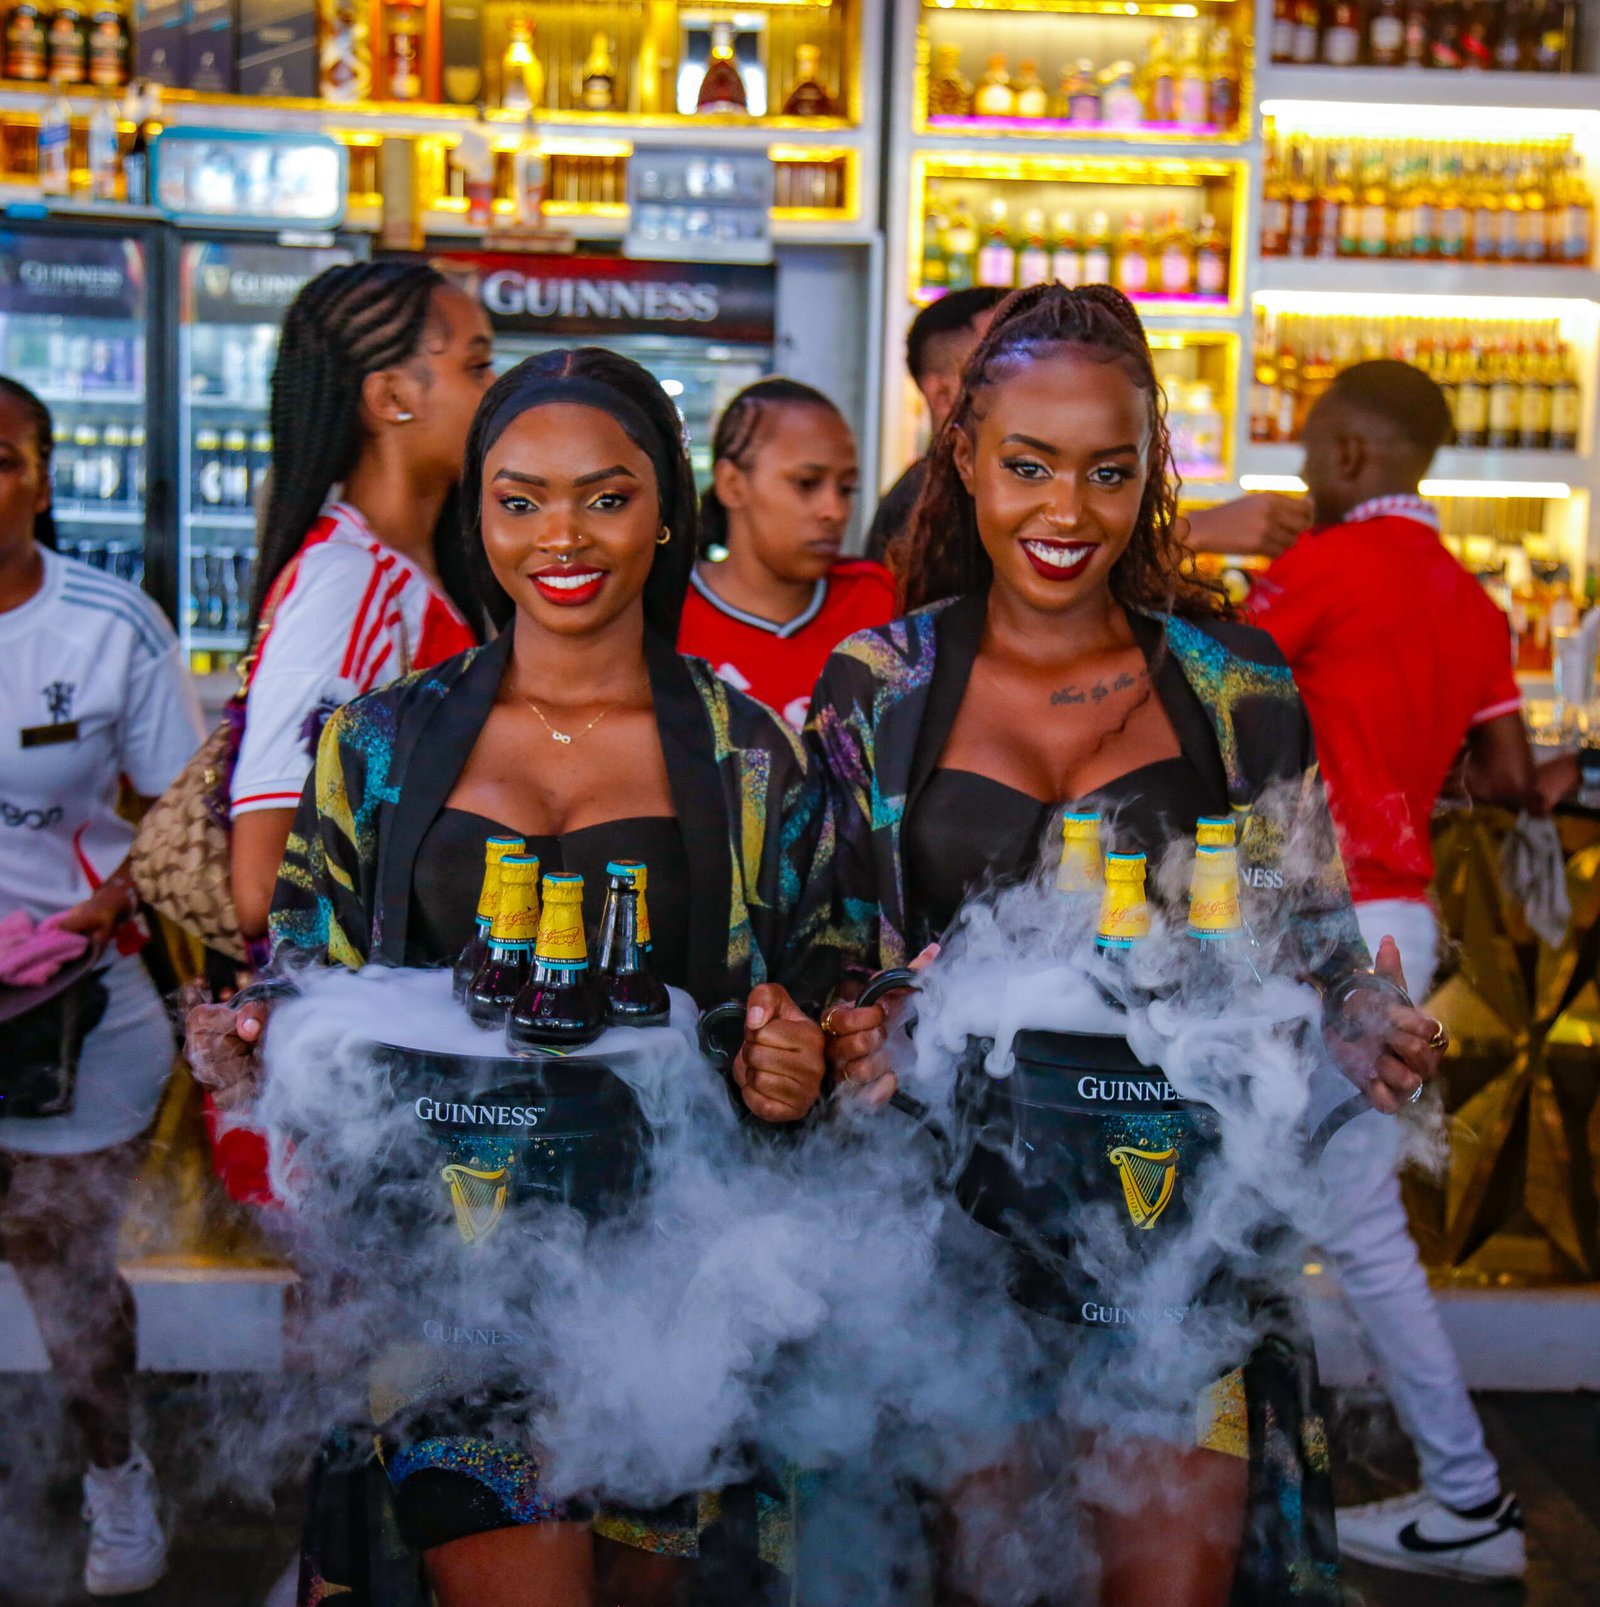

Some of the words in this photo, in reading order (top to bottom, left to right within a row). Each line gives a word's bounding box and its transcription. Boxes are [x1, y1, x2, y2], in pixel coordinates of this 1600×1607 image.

[20, 261, 123, 288] GUINNESS
[231, 271, 306, 298] GUINN
[483, 270, 719, 321] GUINNESS
[1240, 867, 1284, 889] NESS
[1077, 1076, 1185, 1101] GUINNE
[1082, 1302, 1184, 1323] GUINSS
